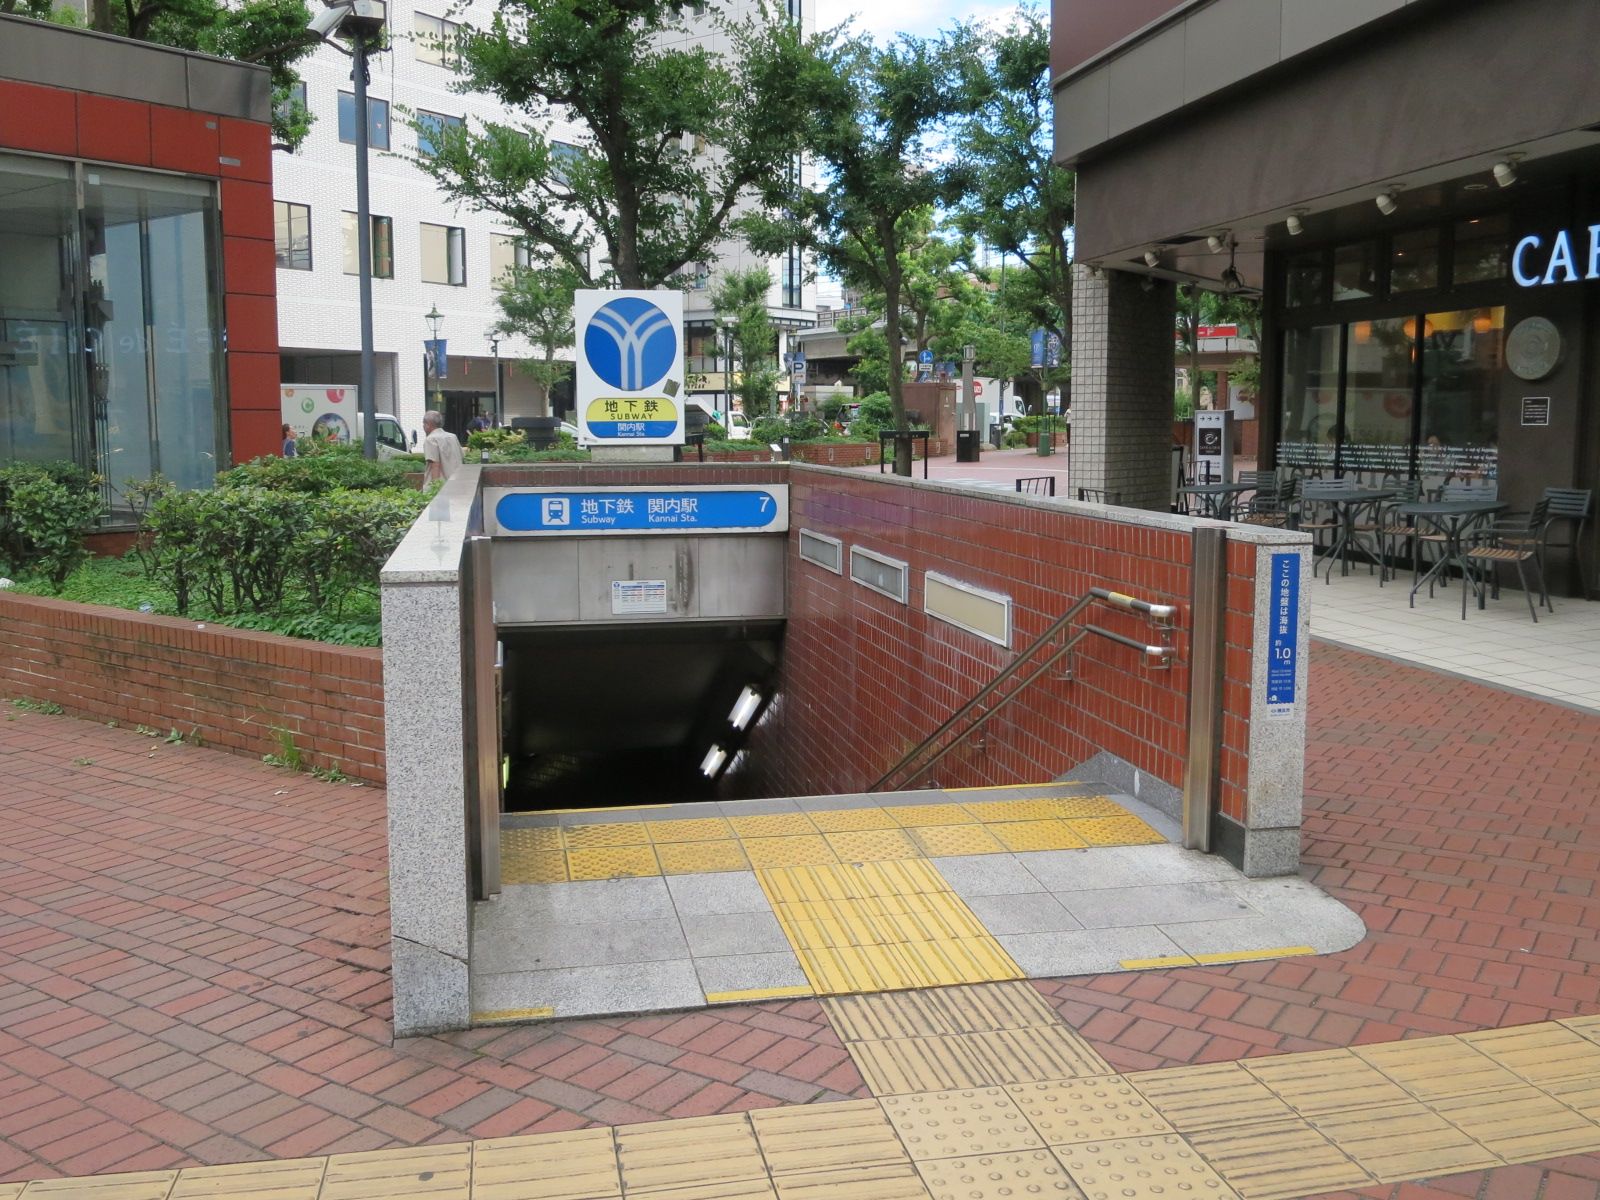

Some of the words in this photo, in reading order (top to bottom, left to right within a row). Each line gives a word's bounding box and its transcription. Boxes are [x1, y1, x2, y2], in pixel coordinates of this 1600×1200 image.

[793, 362, 804, 374] P
[604, 399, 659, 412] 地下鉄
[610, 412, 653, 420] SUBWAY
[617, 422, 645, 431] 関内駅
[580, 498, 634, 514] 地下鉄
[647, 497, 698, 513] 関内駅
[759, 496, 769, 512] 7
[581, 514, 616, 525] Subway
[648, 513, 678, 523] Kannai
[680, 513, 698, 523] Sta.
[1275, 647, 1291, 659] 1.0
